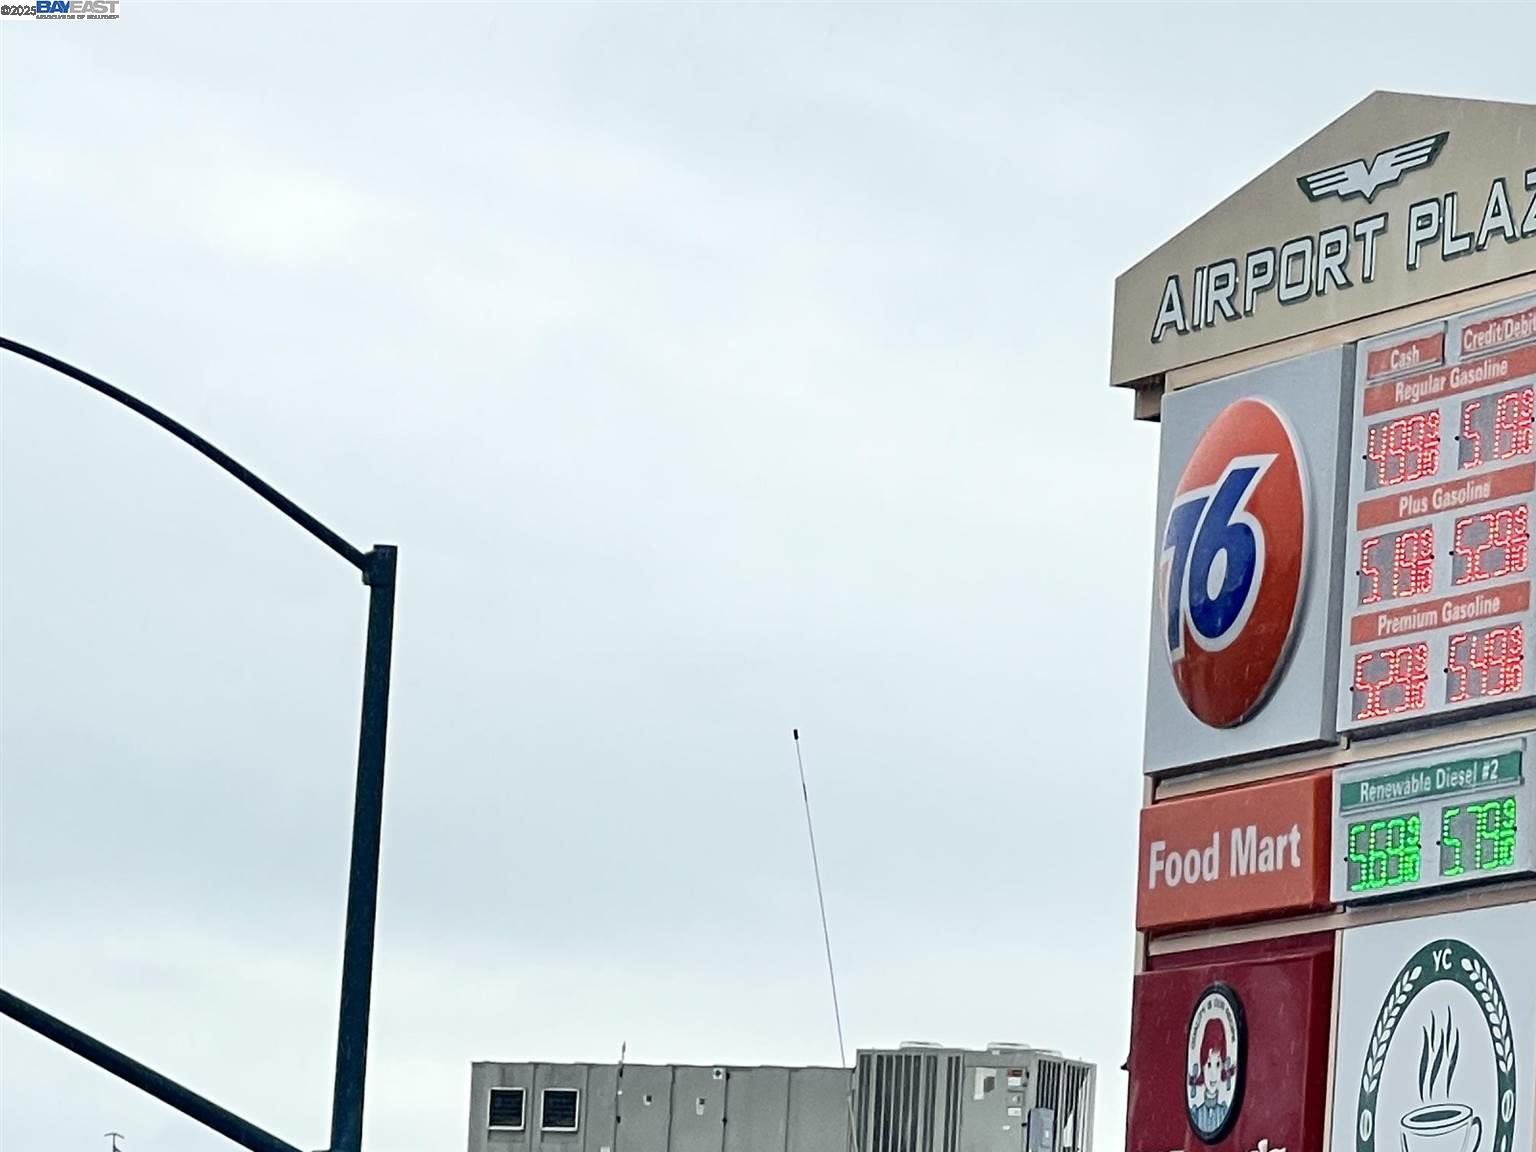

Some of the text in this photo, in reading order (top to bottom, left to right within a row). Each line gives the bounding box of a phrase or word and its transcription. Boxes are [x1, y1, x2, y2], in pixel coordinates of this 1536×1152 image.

[1150, 212, 1388, 343] AIRPORT
[1391, 345, 1419, 369] Cash
[1395, 360, 1508, 402] Regular Gasoline
[1399, 480, 1490, 516] Plus Gasoline
[1160, 453, 1279, 662] 76
[1378, 595, 1500, 636] Premium Gasoline
[1360, 759, 1499, 803] Renewable Diesel #2
[1148, 823, 1301, 888] Food Mart
[1433, 947, 1452, 972] YC
